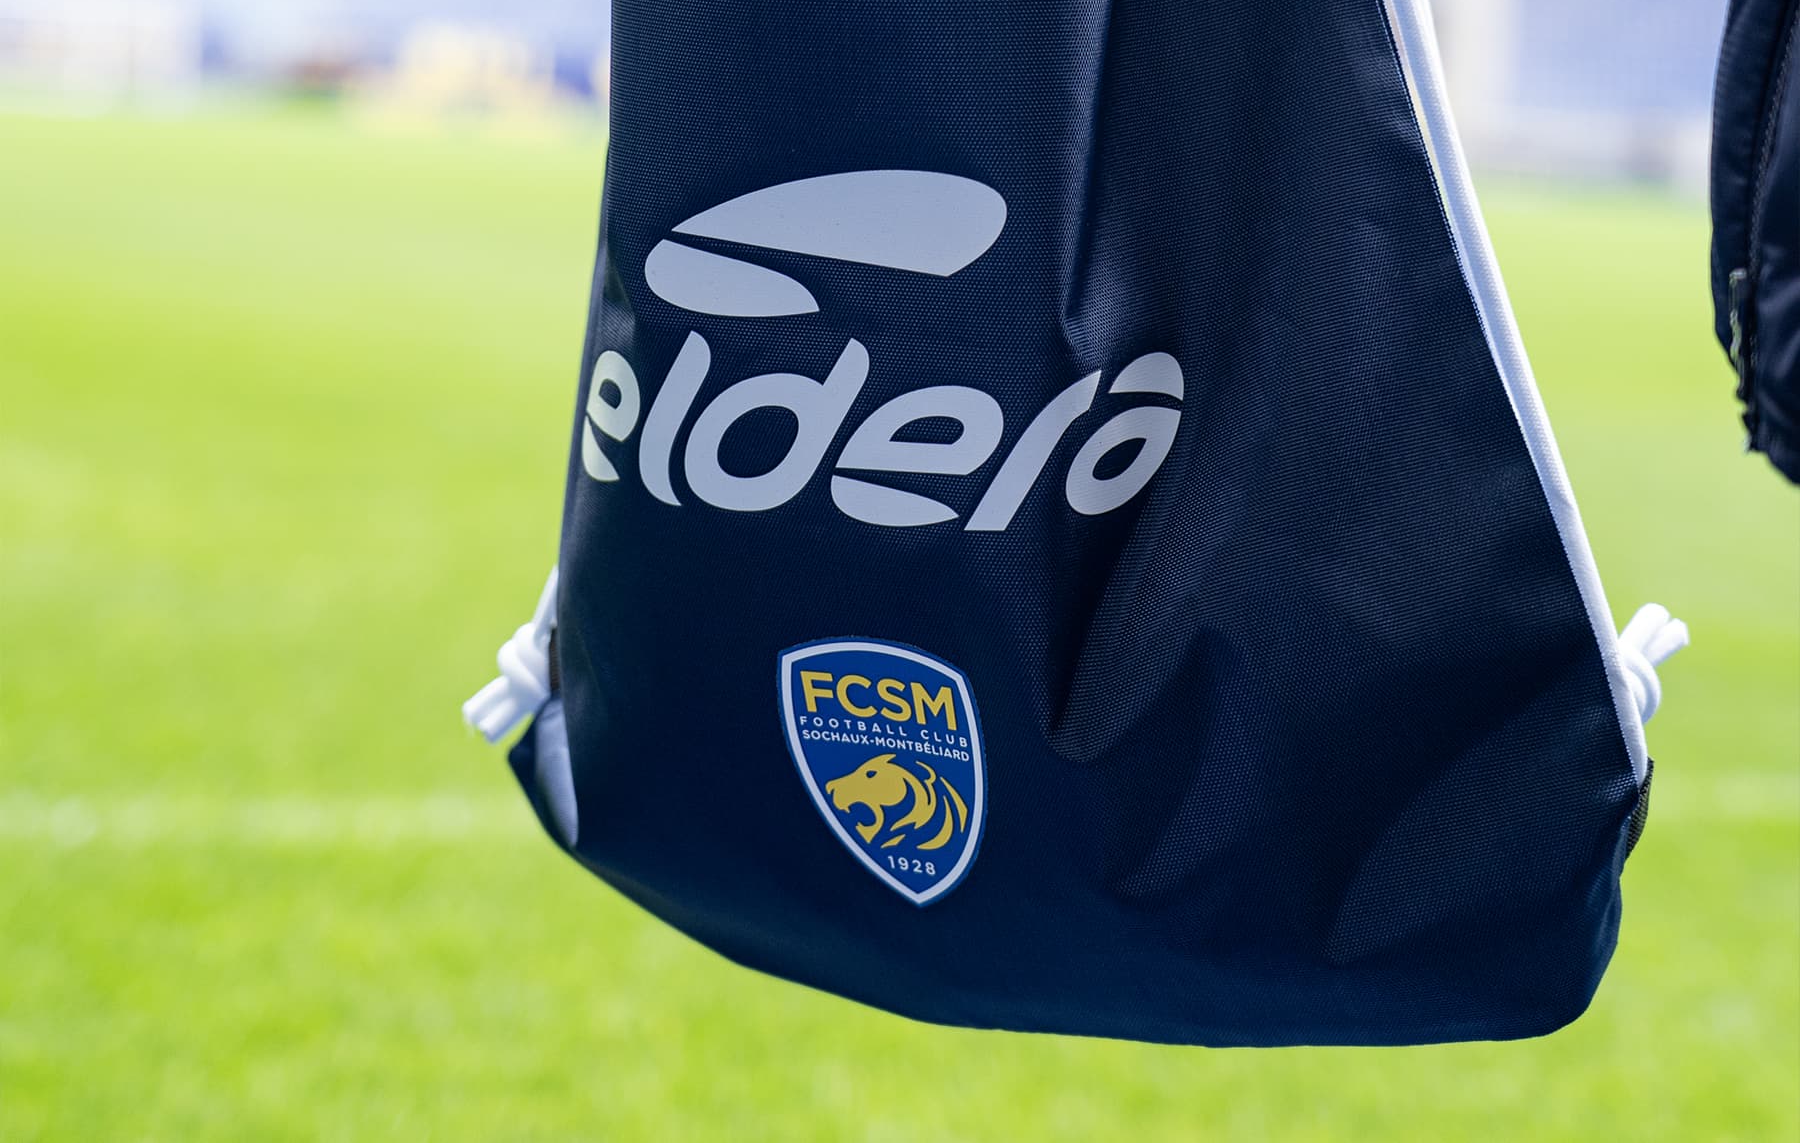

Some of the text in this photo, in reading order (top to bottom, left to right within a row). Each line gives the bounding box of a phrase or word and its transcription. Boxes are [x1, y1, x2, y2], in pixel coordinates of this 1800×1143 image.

[582, 330, 1185, 532] eldera
[799, 670, 958, 731] FCSM
[799, 715, 968, 748] FOOTBALL CLUB
[802, 729, 970, 762] SOCHAUX-MONTBÉLIARD
[887, 855, 936, 875] 1928
